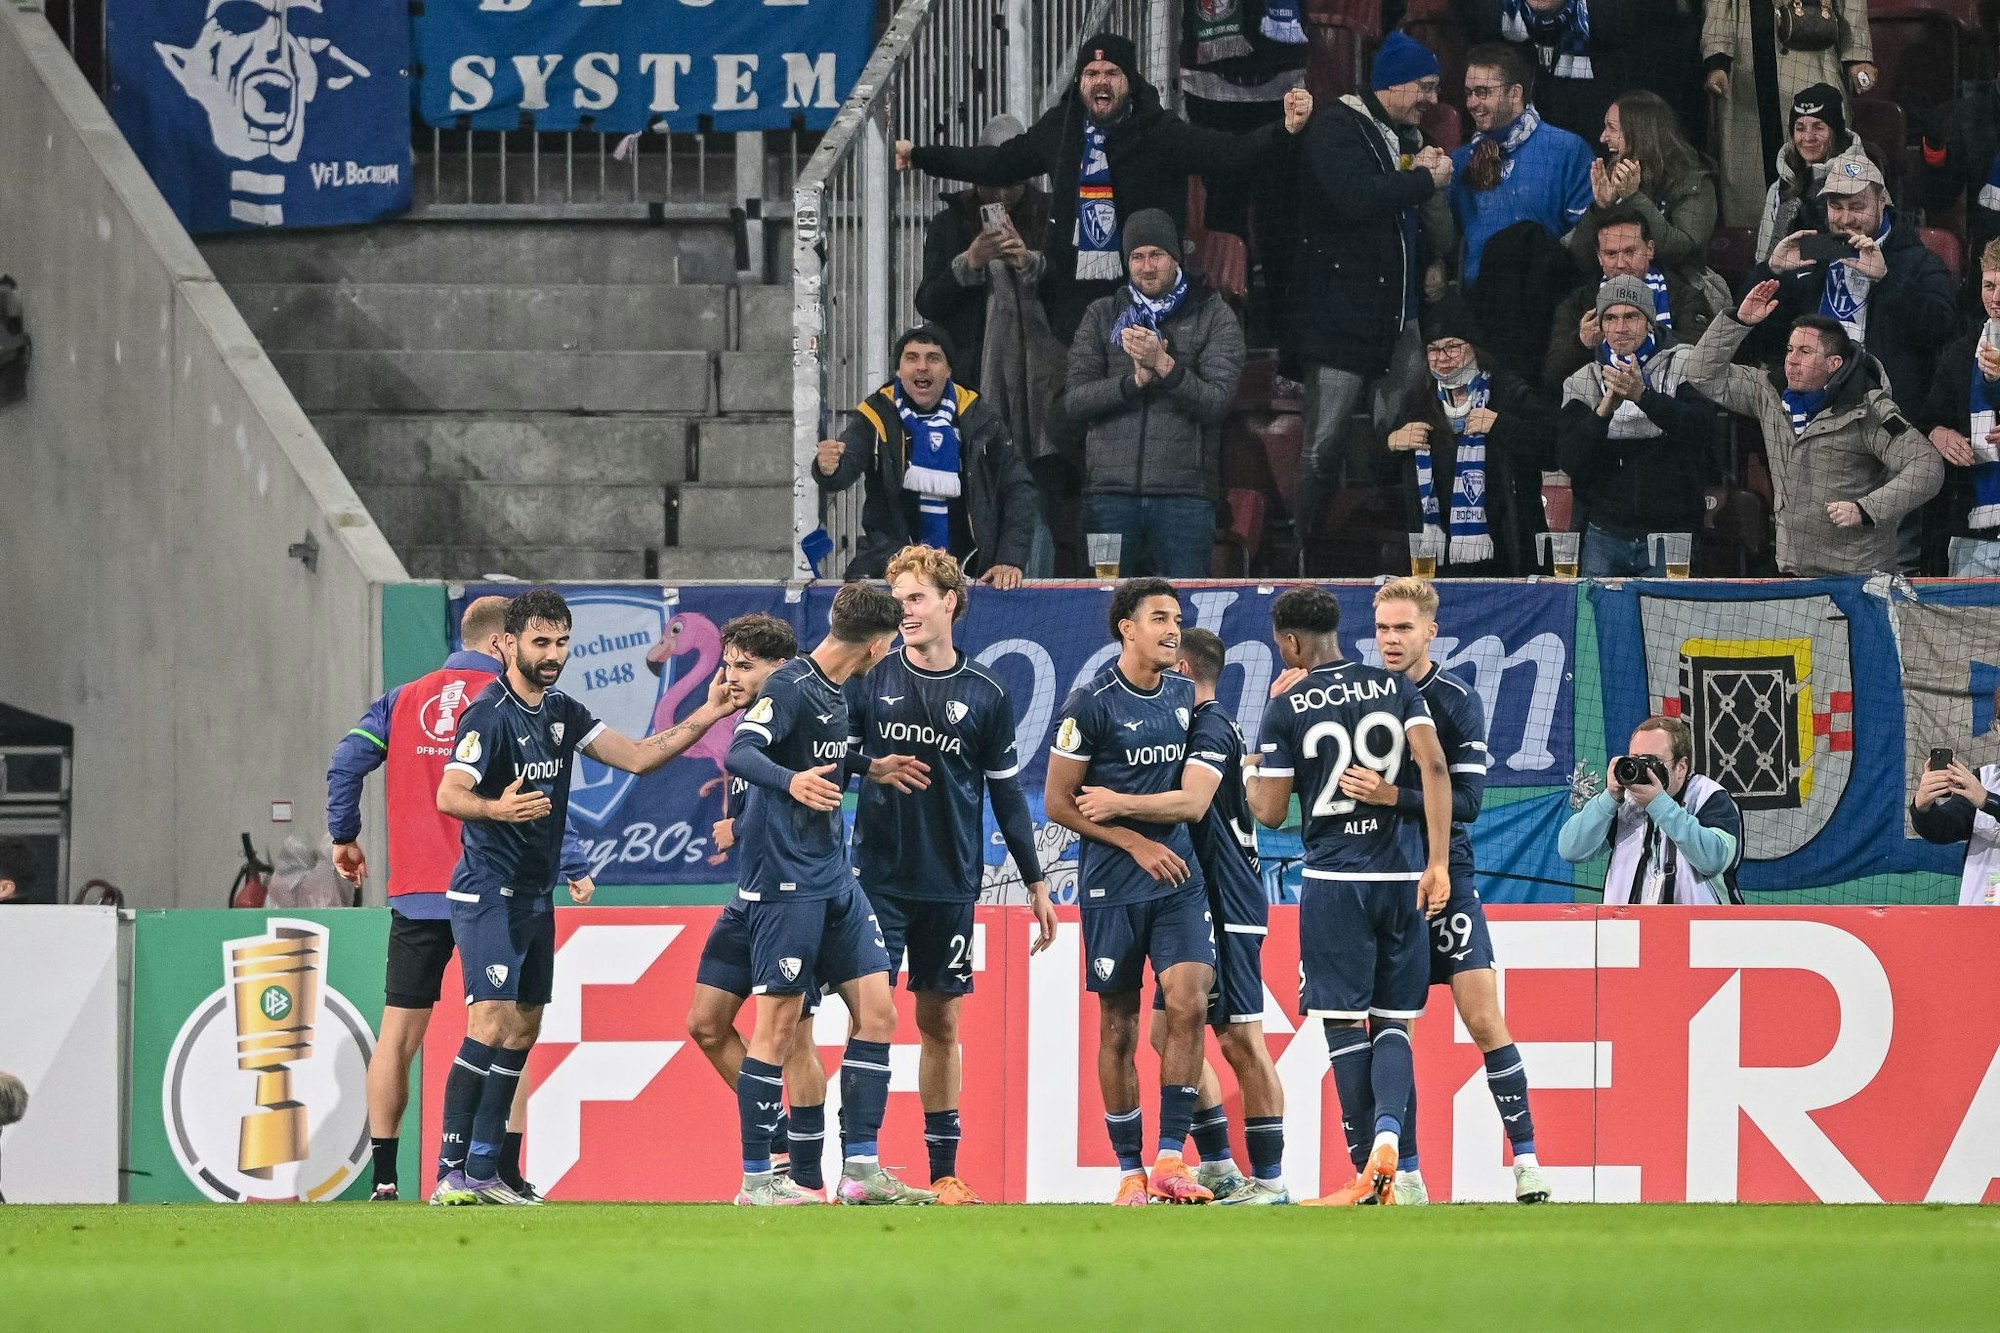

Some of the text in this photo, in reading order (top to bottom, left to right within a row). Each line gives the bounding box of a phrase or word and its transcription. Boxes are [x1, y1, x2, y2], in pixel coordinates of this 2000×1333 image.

[449, 52, 841, 111] SYSTEM
[1616, 288, 1638, 302] 1848
[570, 630, 651, 660] ochum
[583, 662, 635, 691] 1848
[1289, 677, 1397, 714] BOCHUM
[1302, 711, 1406, 817] 29
[1343, 817, 1378, 835] ALFA
[1431, 912, 1472, 953] 39
[947, 934, 975, 969] 24
